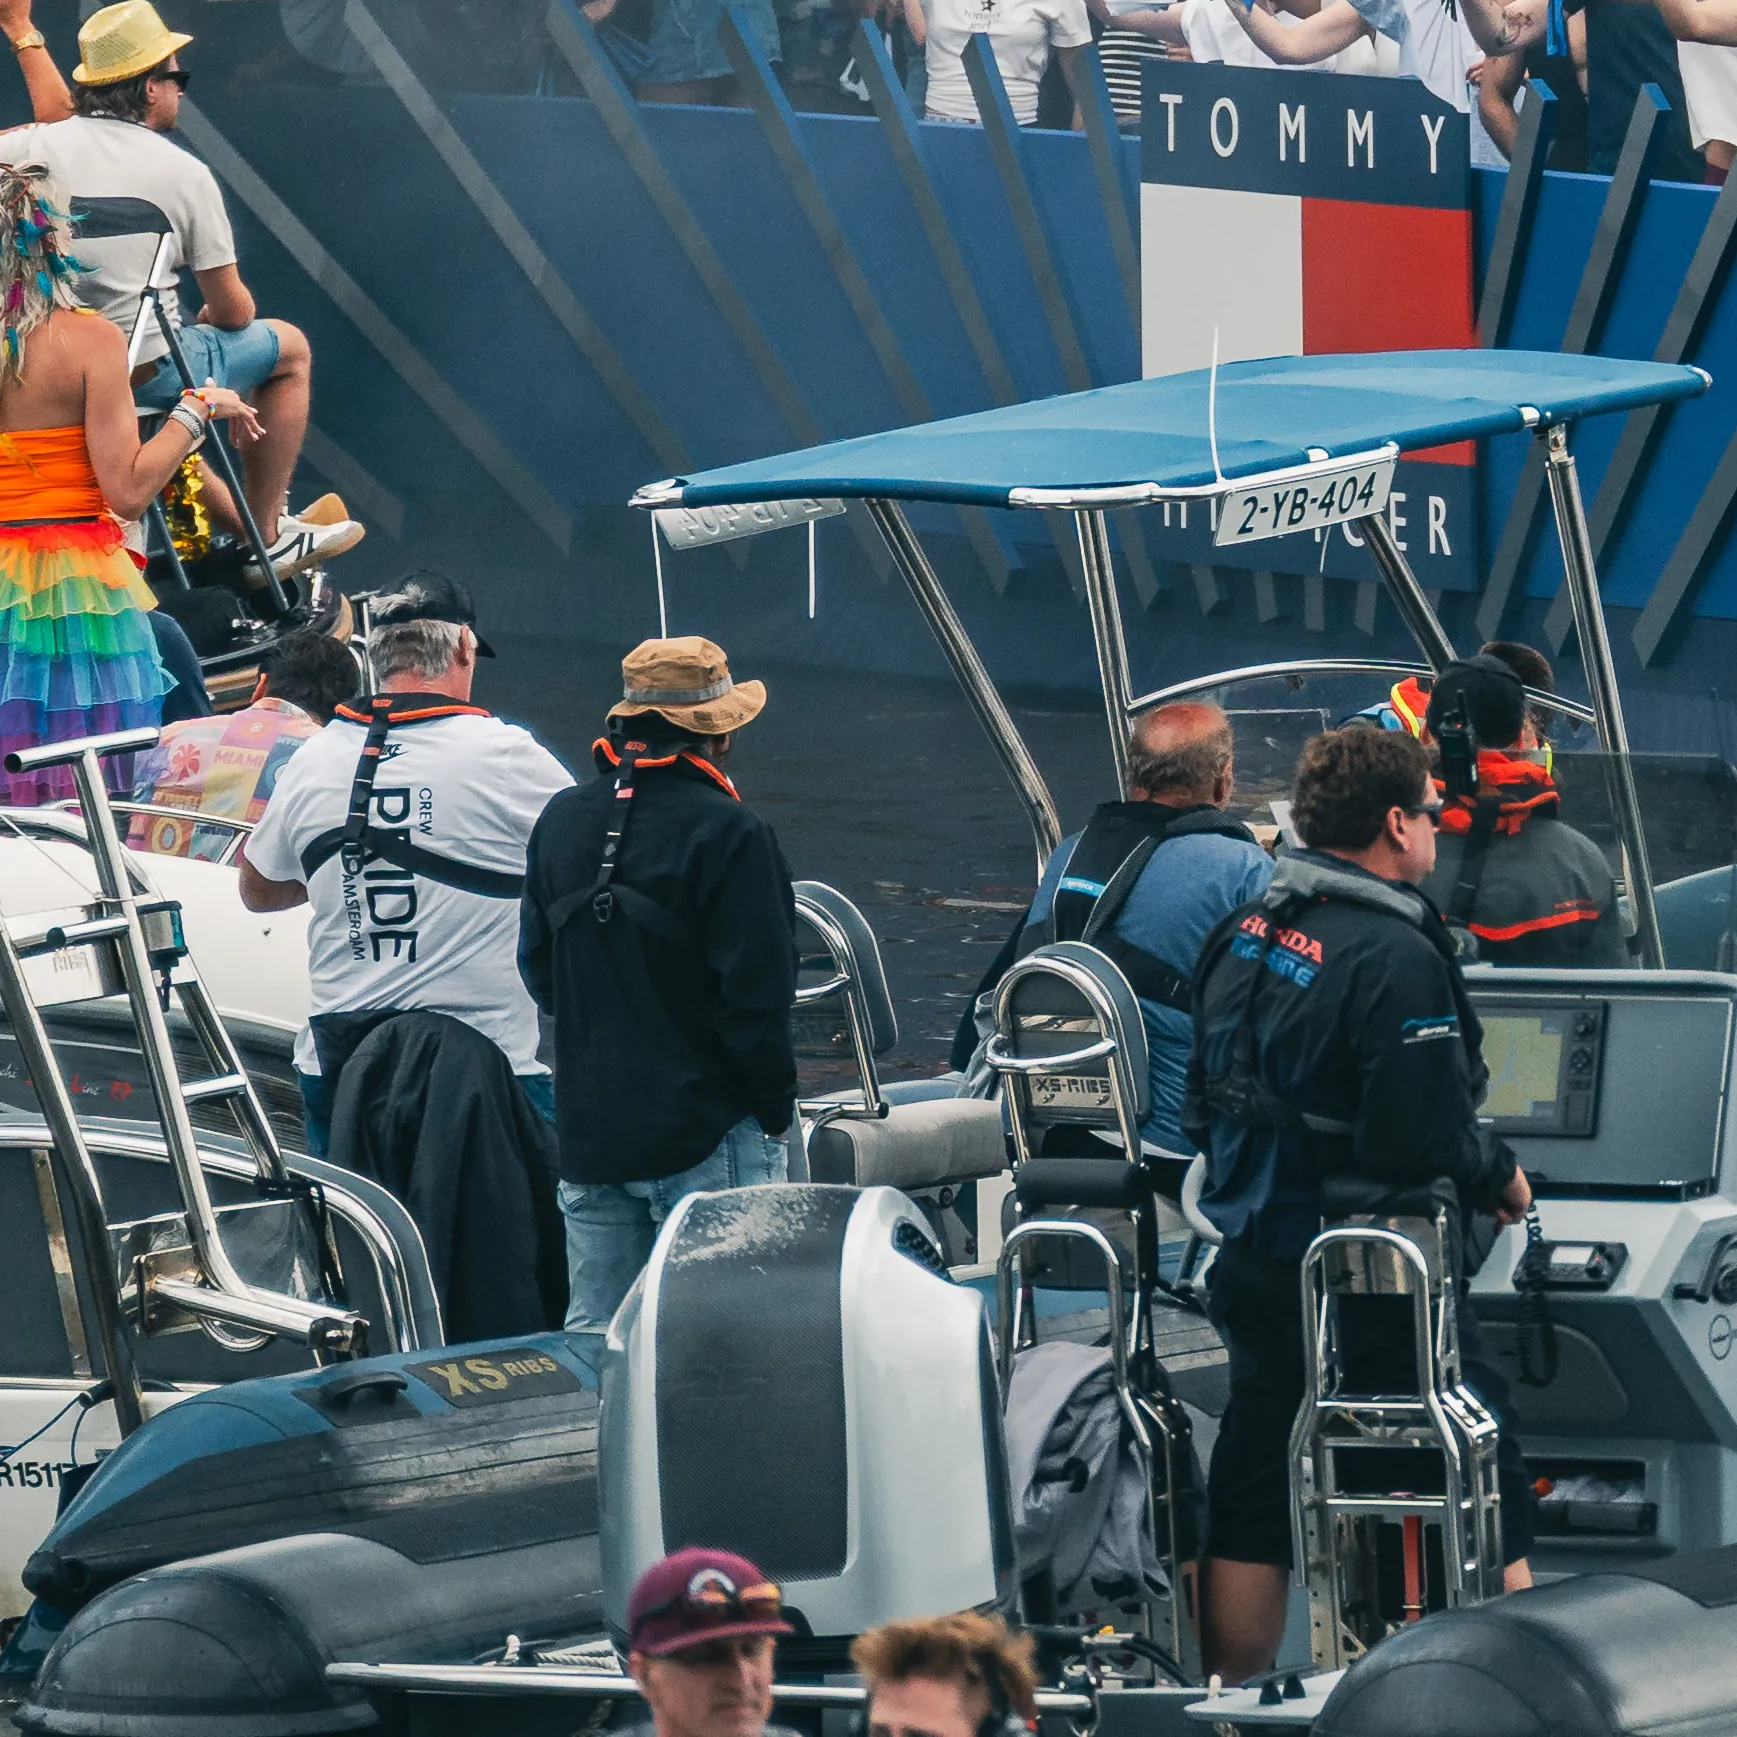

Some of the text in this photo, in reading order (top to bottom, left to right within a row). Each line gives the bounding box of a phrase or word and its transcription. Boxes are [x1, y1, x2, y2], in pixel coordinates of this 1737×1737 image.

[1159, 94, 1446, 174] TOMMY
[1237, 471, 1378, 536] 2-YB-404
[418, 787, 432, 836] CREW
[1035, 1077, 1112, 1094] XS-RIBS
[427, 1357, 558, 1397] XS RIBS
